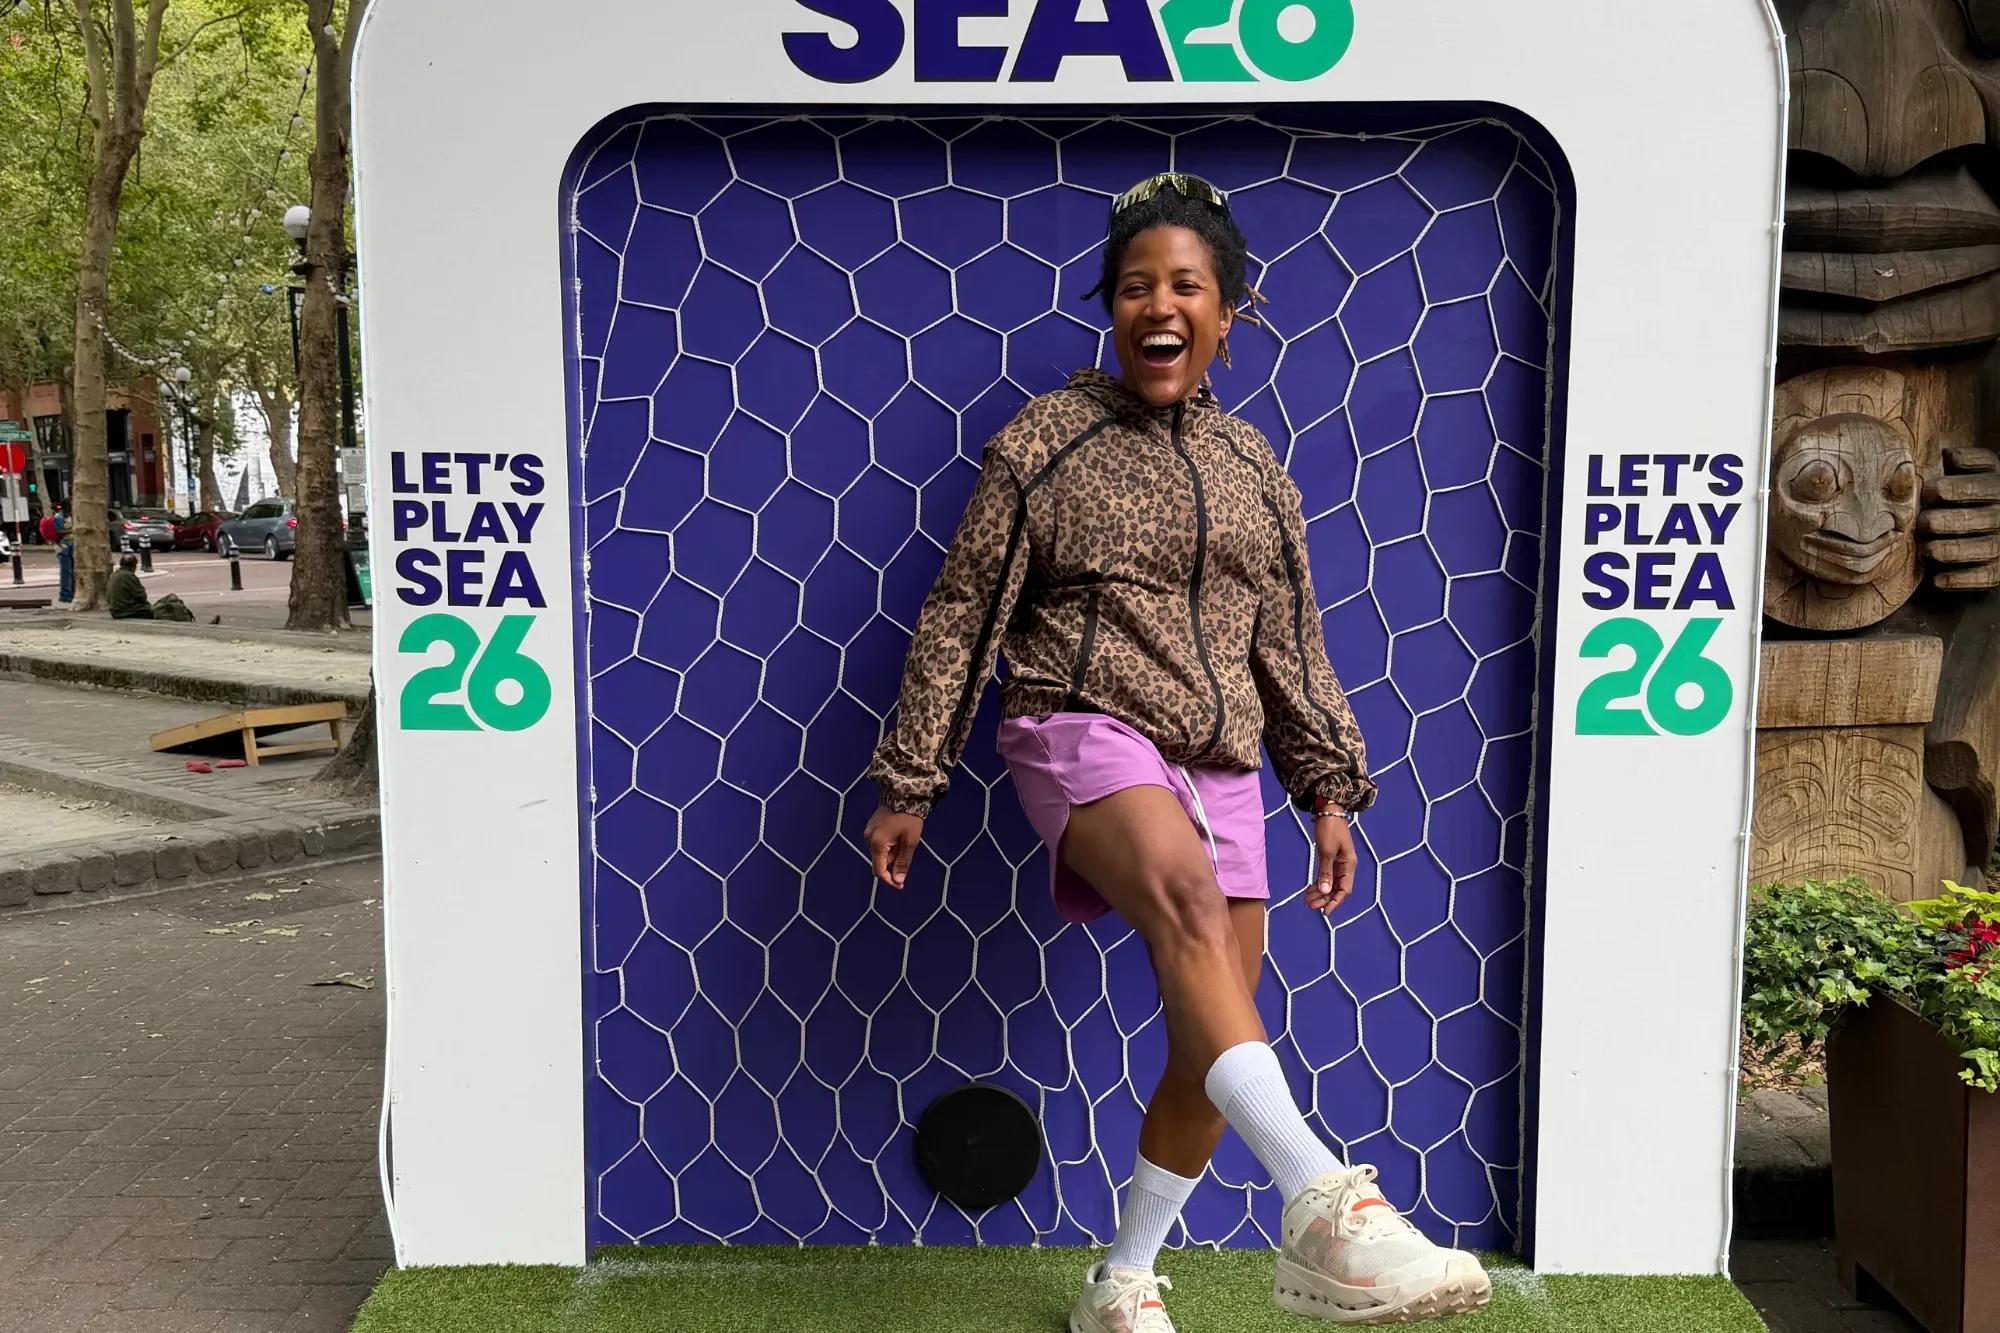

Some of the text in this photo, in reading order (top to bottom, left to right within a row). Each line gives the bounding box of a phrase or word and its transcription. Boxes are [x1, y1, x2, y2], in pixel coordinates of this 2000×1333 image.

[391, 452, 545, 496] LET'S
[1587, 454, 1744, 497] LET'S
[393, 500, 545, 544] PLAY
[1585, 503, 1742, 545] PLAY
[396, 548, 547, 608] SEA
[1582, 551, 1736, 610] SEA
[398, 613, 552, 732] 26
[1575, 617, 1733, 736] 26
